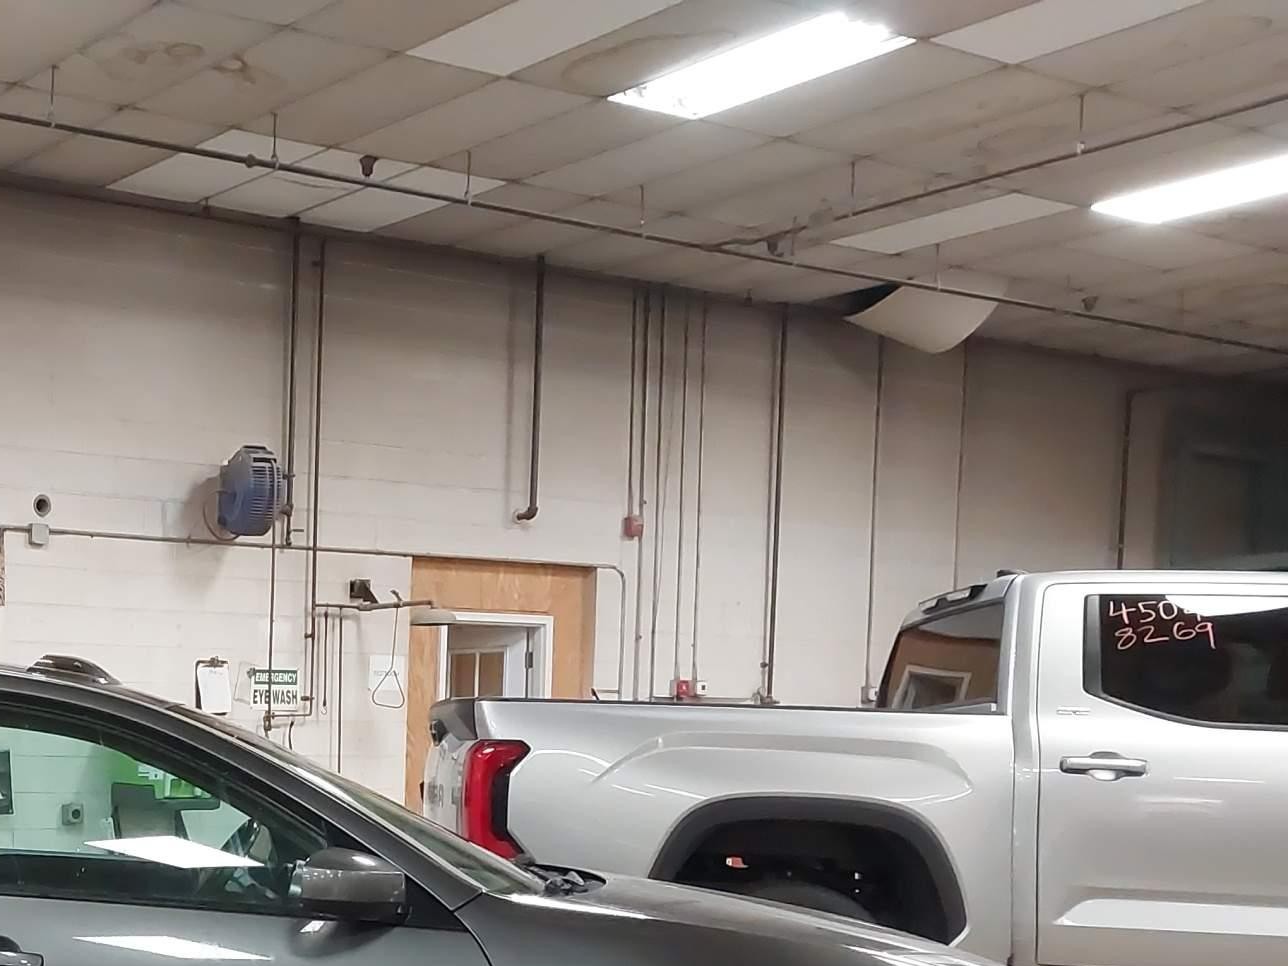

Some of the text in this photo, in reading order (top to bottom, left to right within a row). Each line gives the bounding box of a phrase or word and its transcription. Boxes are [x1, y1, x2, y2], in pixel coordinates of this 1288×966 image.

[1114, 622, 1216, 649] 8269
[253, 689, 298, 704] EYE WASH
